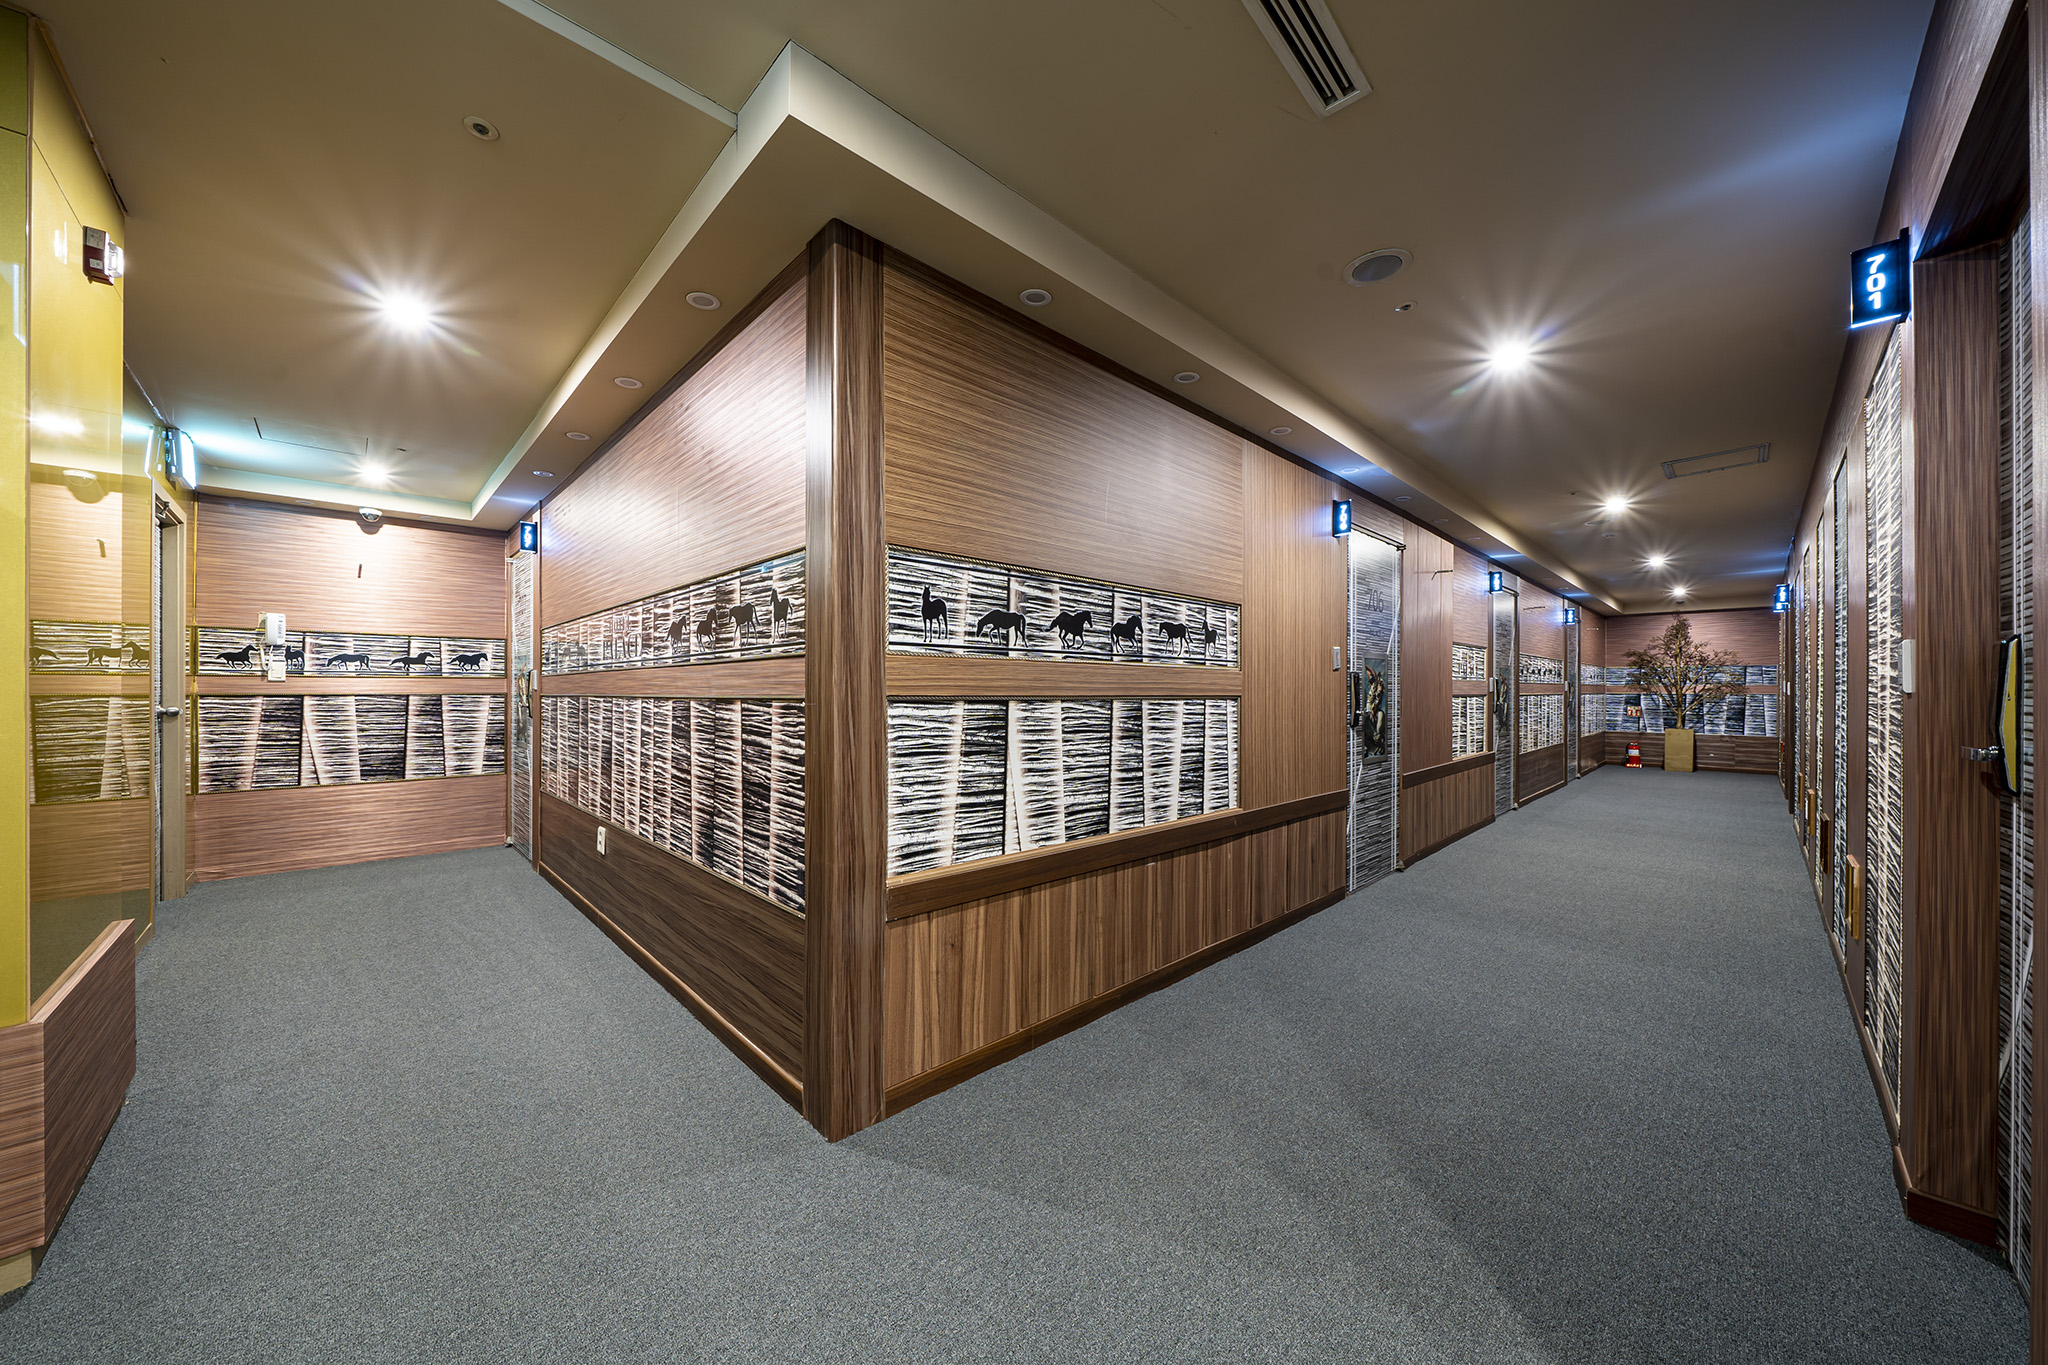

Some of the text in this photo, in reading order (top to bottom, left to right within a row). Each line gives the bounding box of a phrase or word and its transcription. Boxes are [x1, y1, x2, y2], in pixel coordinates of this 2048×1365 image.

[1867, 253, 1886, 310] 701
[1339, 504, 1348, 531] 706
[524, 525, 532, 548] 707
